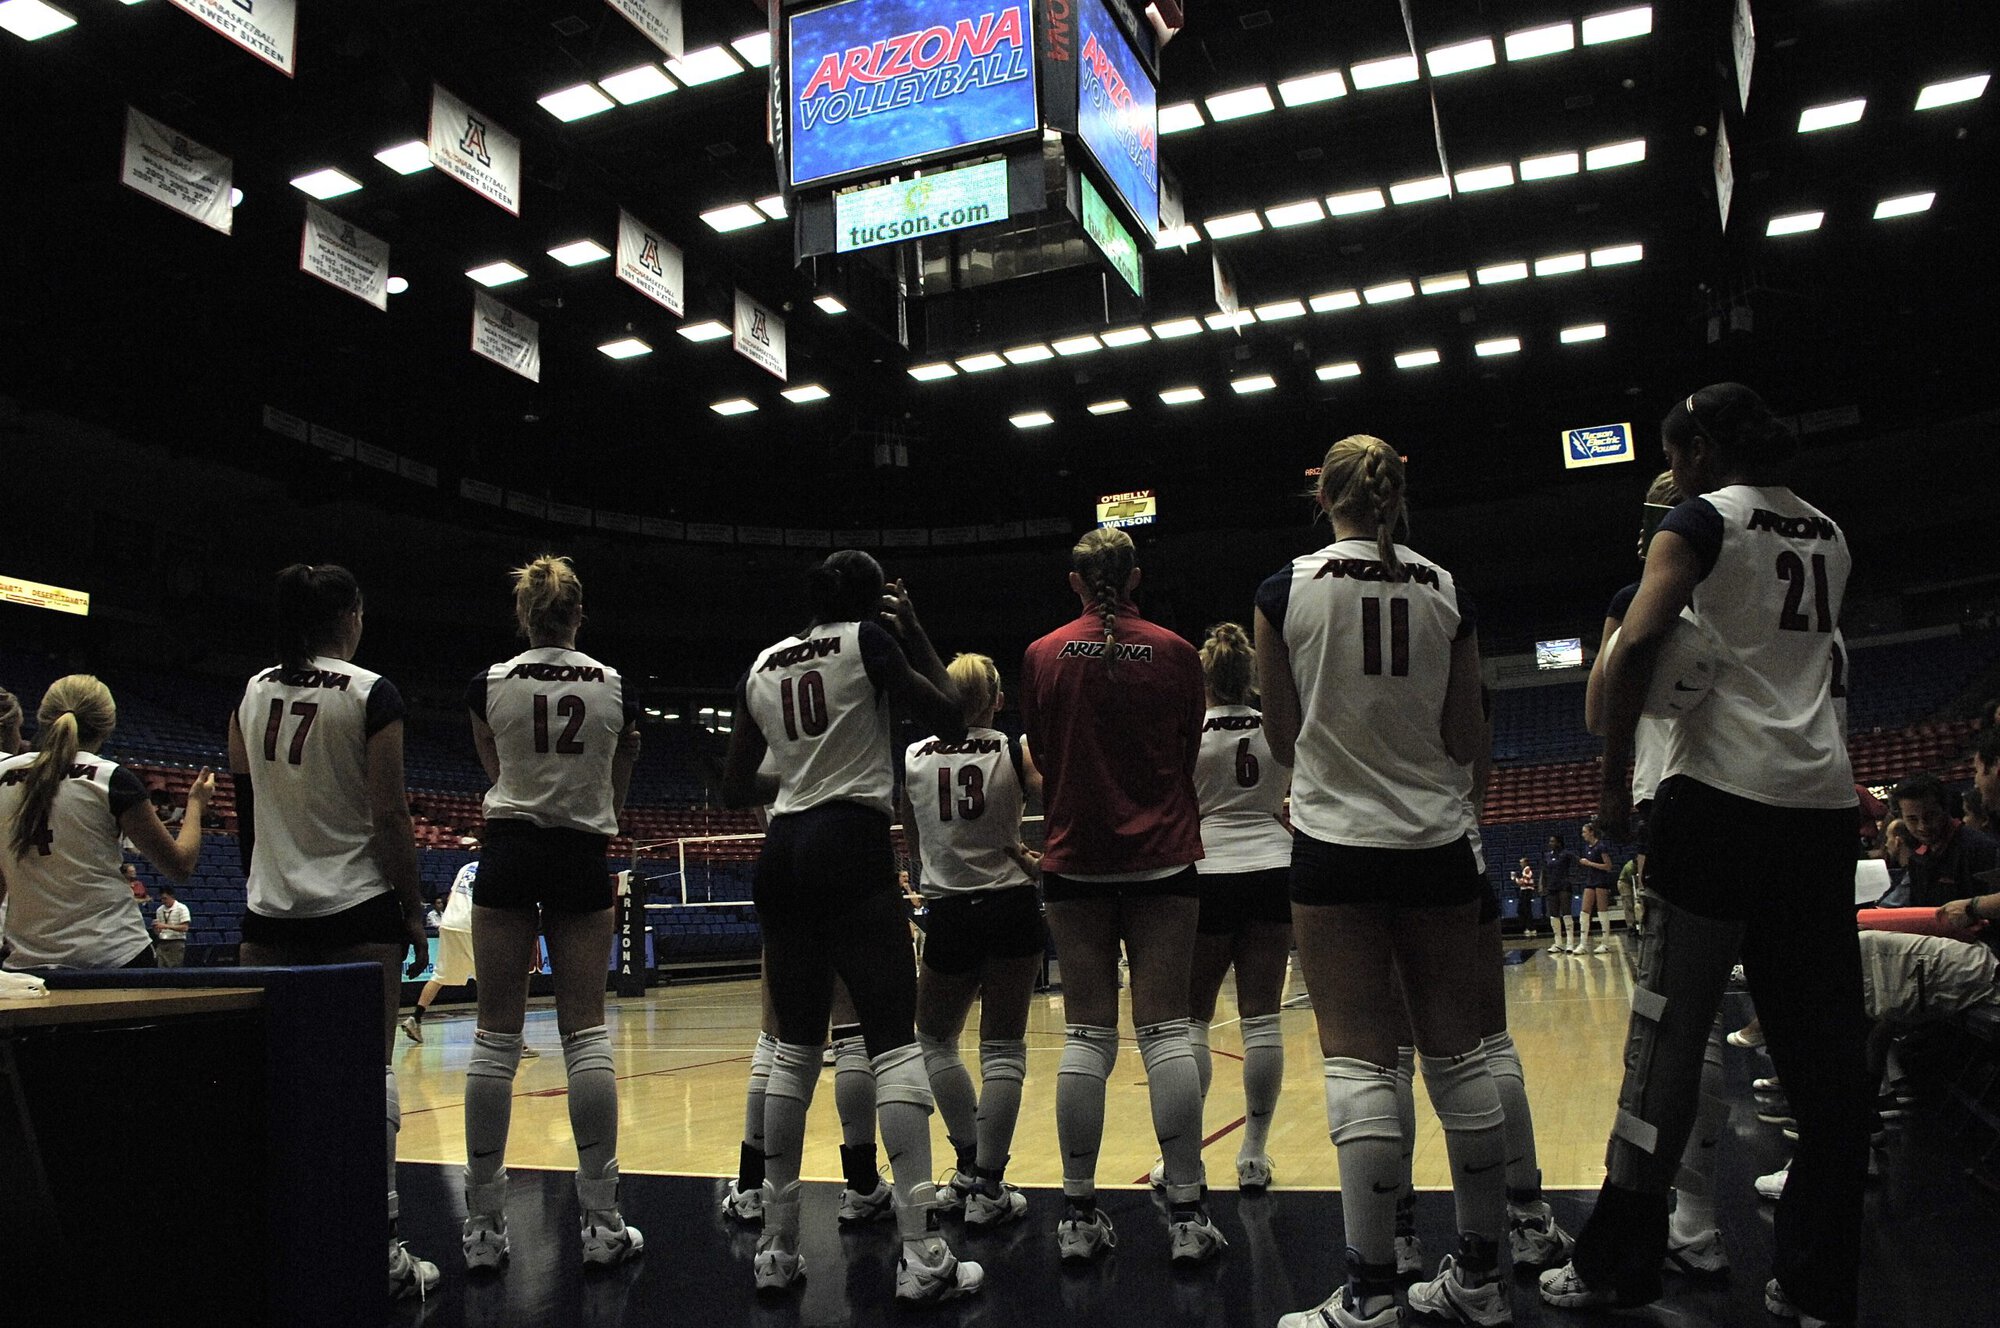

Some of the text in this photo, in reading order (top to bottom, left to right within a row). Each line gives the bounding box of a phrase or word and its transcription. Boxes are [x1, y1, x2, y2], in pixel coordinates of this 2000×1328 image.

[200, 4, 237, 32] SWEET
[240, 30, 284, 63] SIXTEEN
[623, 1, 668, 44] ELITE EIGHT
[801, 6, 1022, 99] ARIZONA
[800, 48, 1028, 130] VOLLEYBALL
[442, 147, 508, 193] ARIZONABASKETBALL
[454, 165, 480, 185] SWEET
[482, 182, 513, 206] SIXTEEN
[850, 203, 990, 246] tucson.com
[318, 243, 335, 257] NCAA
[636, 279, 654, 293] SWEET
[656, 291, 679, 308] SIXTEEN
[1582, 430, 1614, 441] Tucson
[1586, 436, 1621, 447] Electric
[1590, 443, 1622, 454] Power
[1101, 490, 1150, 504] O'RIELLY
[1102, 516, 1152, 529] WATSON
[1776, 550, 1832, 633] 21
[756, 636, 841, 674] ARIZONA
[1362, 597, 1410, 677] 11
[505, 663, 605, 683] ARIZONA
[533, 694, 586, 755] 12
[781, 670, 829, 742] 10
[1201, 715, 1263, 733] ARIZON
[264, 698, 319, 766] 17
[914, 738, 1001, 758] ARIZONA
[0, 764, 99, 787] ARNA
[1235, 737, 1260, 788] 6
[938, 764, 985, 822] 13
[622, 883, 632, 975] ARIZONA
